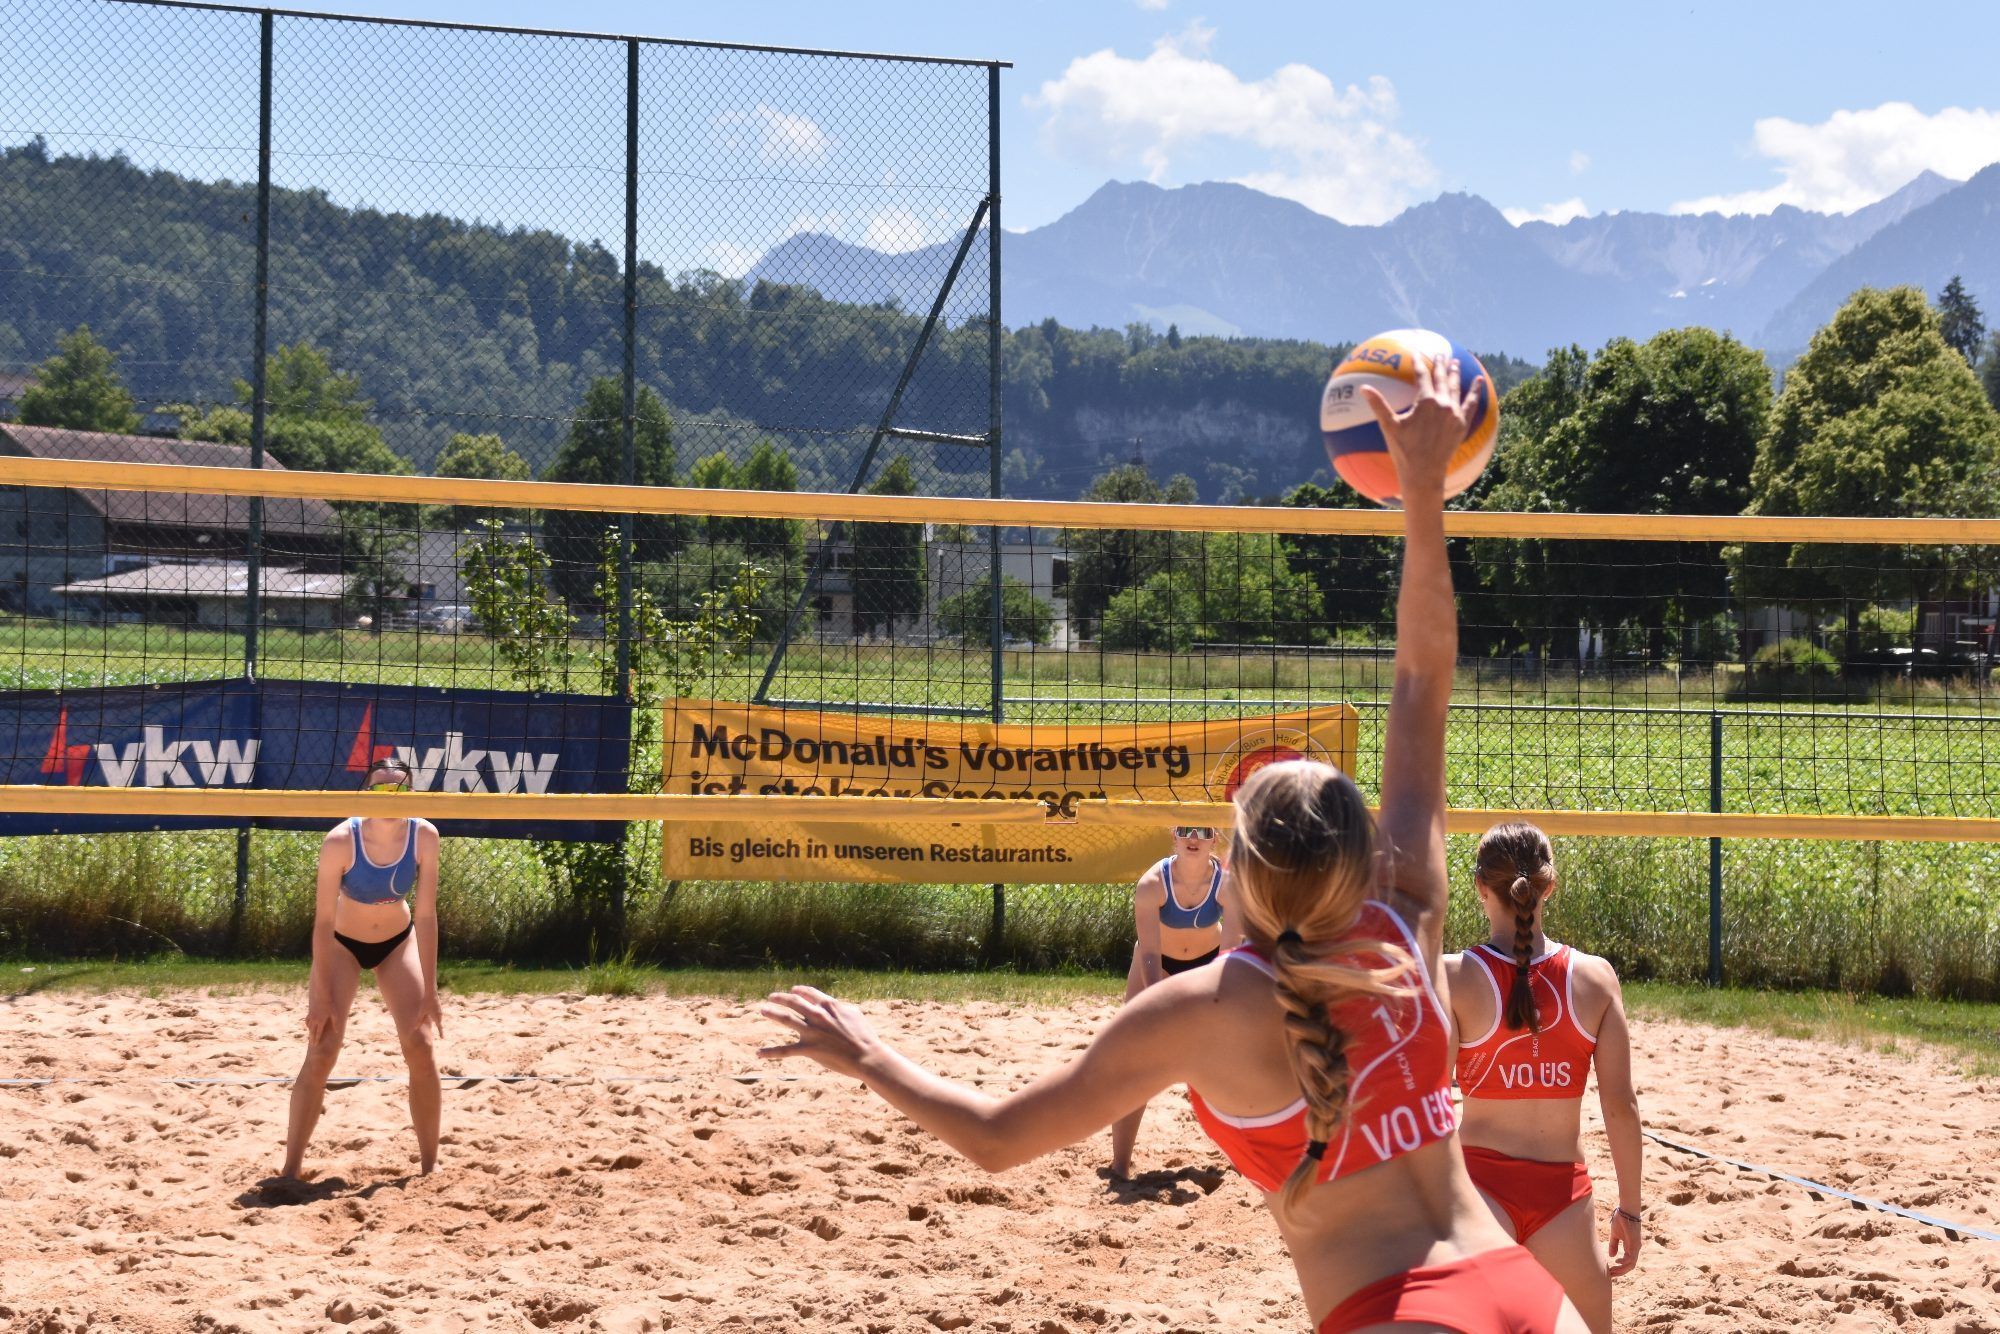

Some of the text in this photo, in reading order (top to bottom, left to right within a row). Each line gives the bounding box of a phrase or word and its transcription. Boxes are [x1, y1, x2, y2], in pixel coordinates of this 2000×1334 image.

[1347, 348, 1402, 371] ASA
[93, 724, 262, 787] vkw
[396, 731, 559, 794] vkw
[690, 723, 1191, 778] McDonald's Vorarlberg
[689, 836, 1073, 863] Bis gleich in unseren Restaurants.
[1499, 1062, 1534, 1089] VO
[1361, 1105, 1422, 1161] VO
